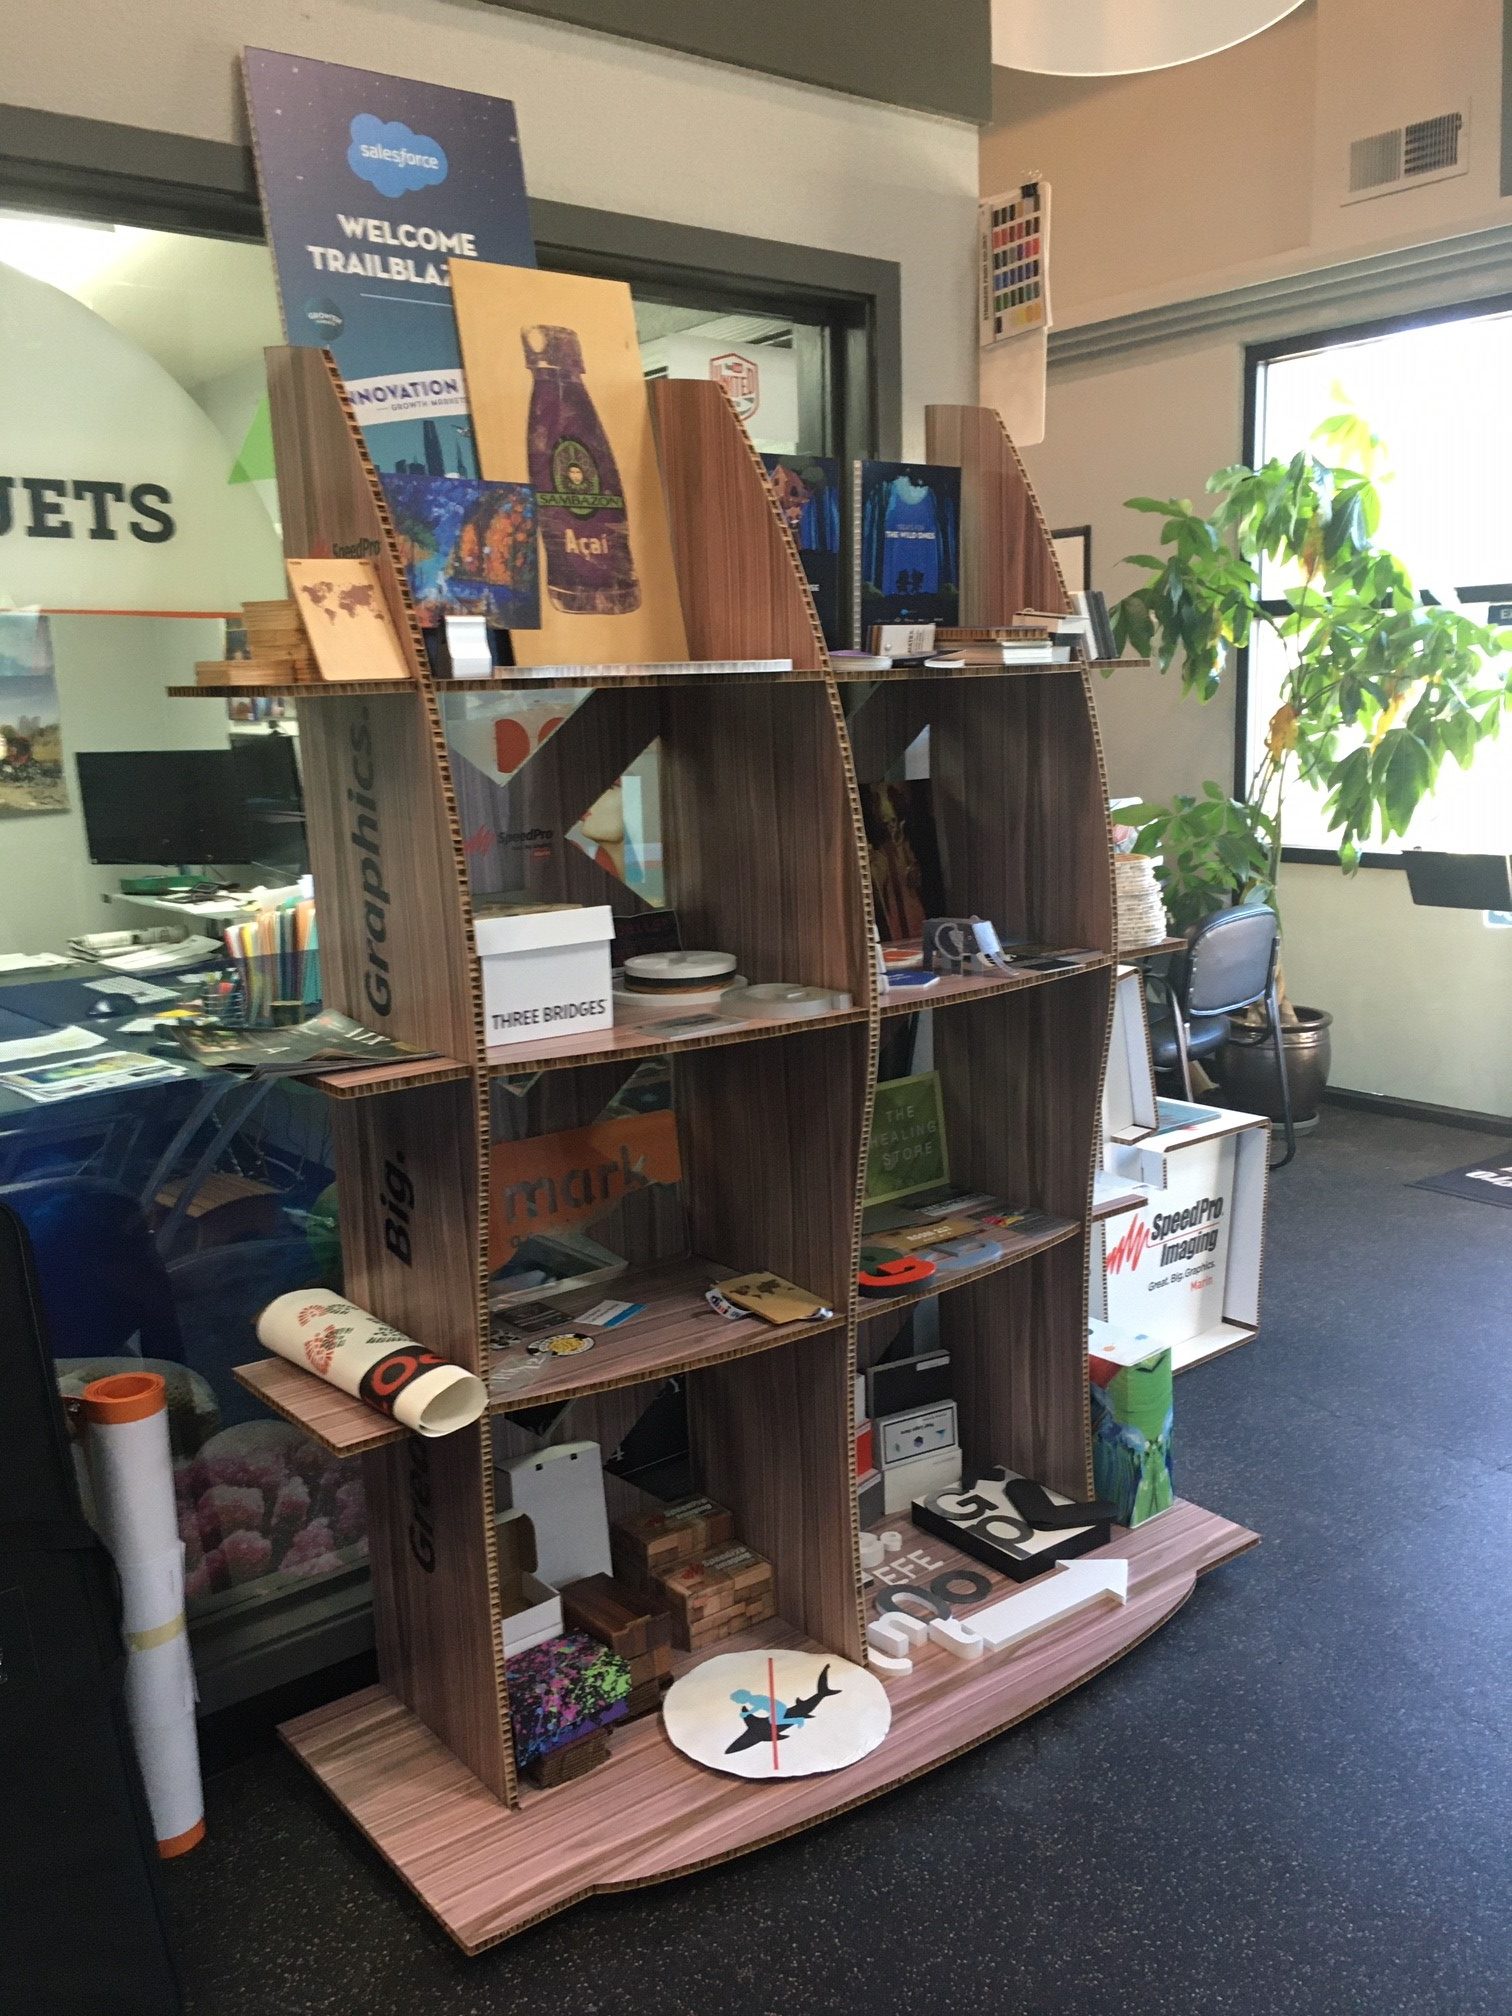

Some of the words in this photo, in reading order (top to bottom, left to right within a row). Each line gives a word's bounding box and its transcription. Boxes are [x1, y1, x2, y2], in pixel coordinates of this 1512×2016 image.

[360, 144, 439, 169] salesforce
[336, 213, 478, 257] WELCOME
[541, 494, 619, 506] SAMBAZON
[492, 1009, 540, 1030] THREE
[543, 999, 608, 1022] BRIDGES
[380, 1150, 415, 1269] Big.
[1151, 1196, 1225, 1241] SpeedPro
[1160, 1228, 1219, 1267] Imaging
